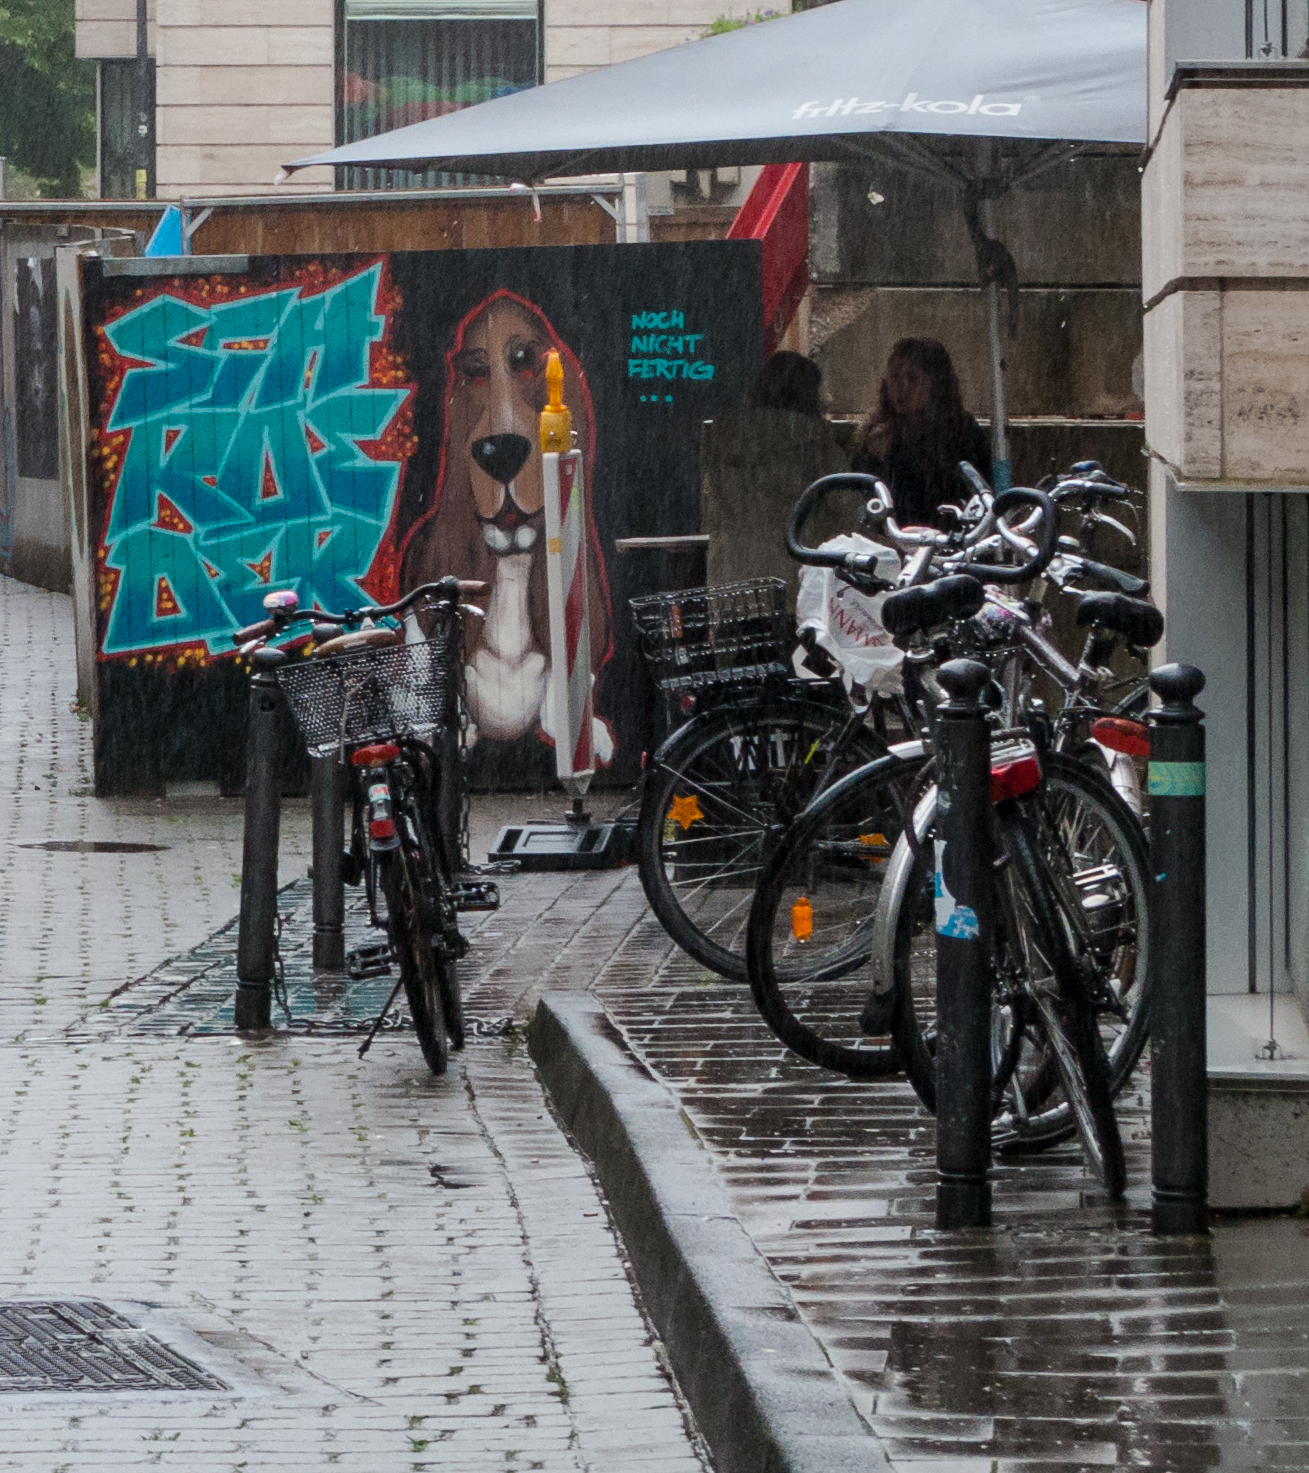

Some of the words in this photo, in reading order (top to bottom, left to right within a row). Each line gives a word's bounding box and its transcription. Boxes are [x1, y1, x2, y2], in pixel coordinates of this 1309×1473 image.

[792, 92, 1022, 120] fritz-kola
[631, 309, 684, 330] NOCH
[630, 333, 704, 354] NICHT
[628, 358, 715, 381] FERTIG
